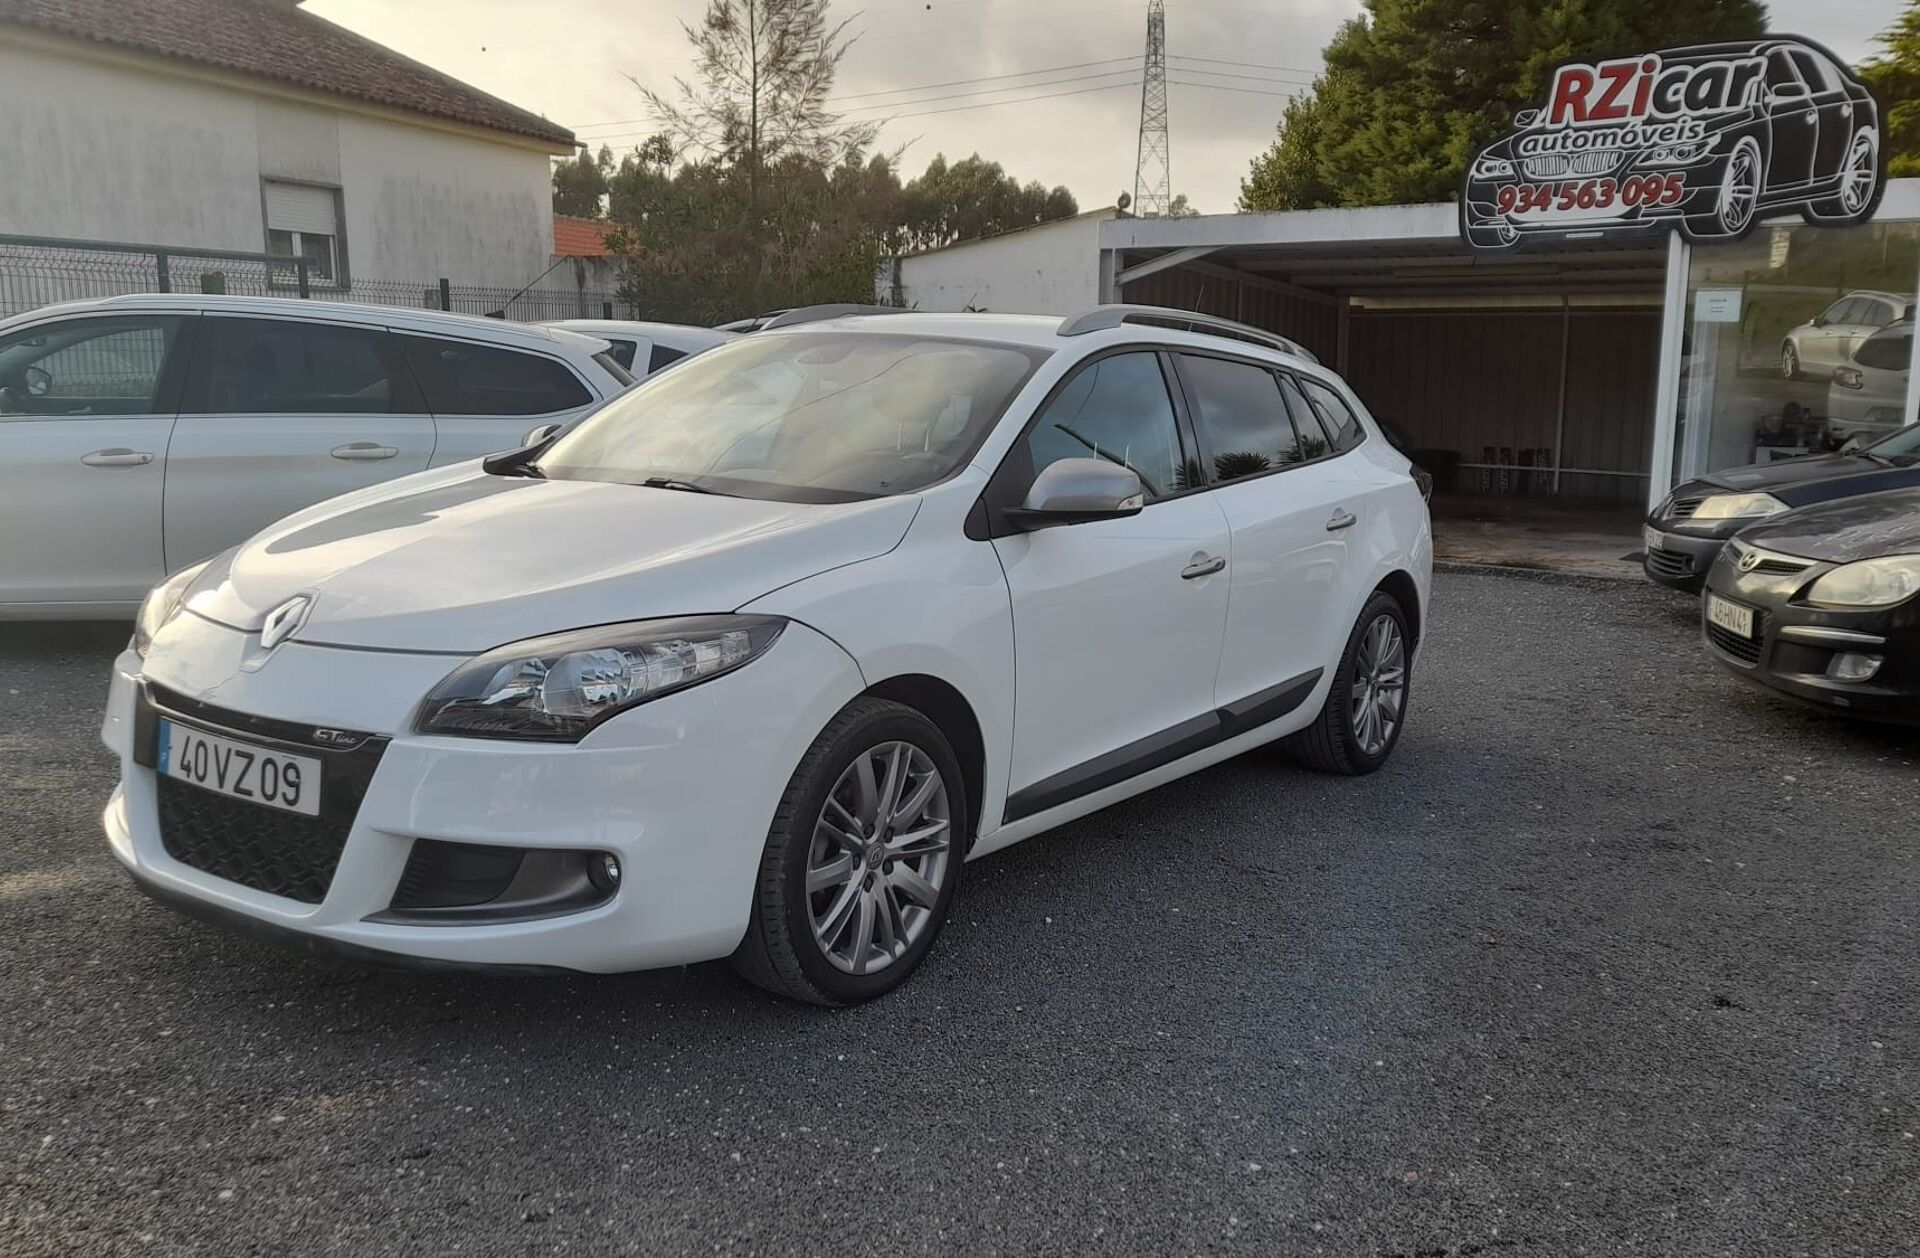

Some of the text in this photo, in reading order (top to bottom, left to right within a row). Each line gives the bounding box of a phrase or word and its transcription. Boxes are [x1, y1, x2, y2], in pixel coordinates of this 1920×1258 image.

[1549, 58, 1765, 124] RZicar
[1522, 123, 1702, 155] automóveis
[1498, 173, 1686, 215] 934 563 095
[180, 735, 301, 807] 40VZ09
